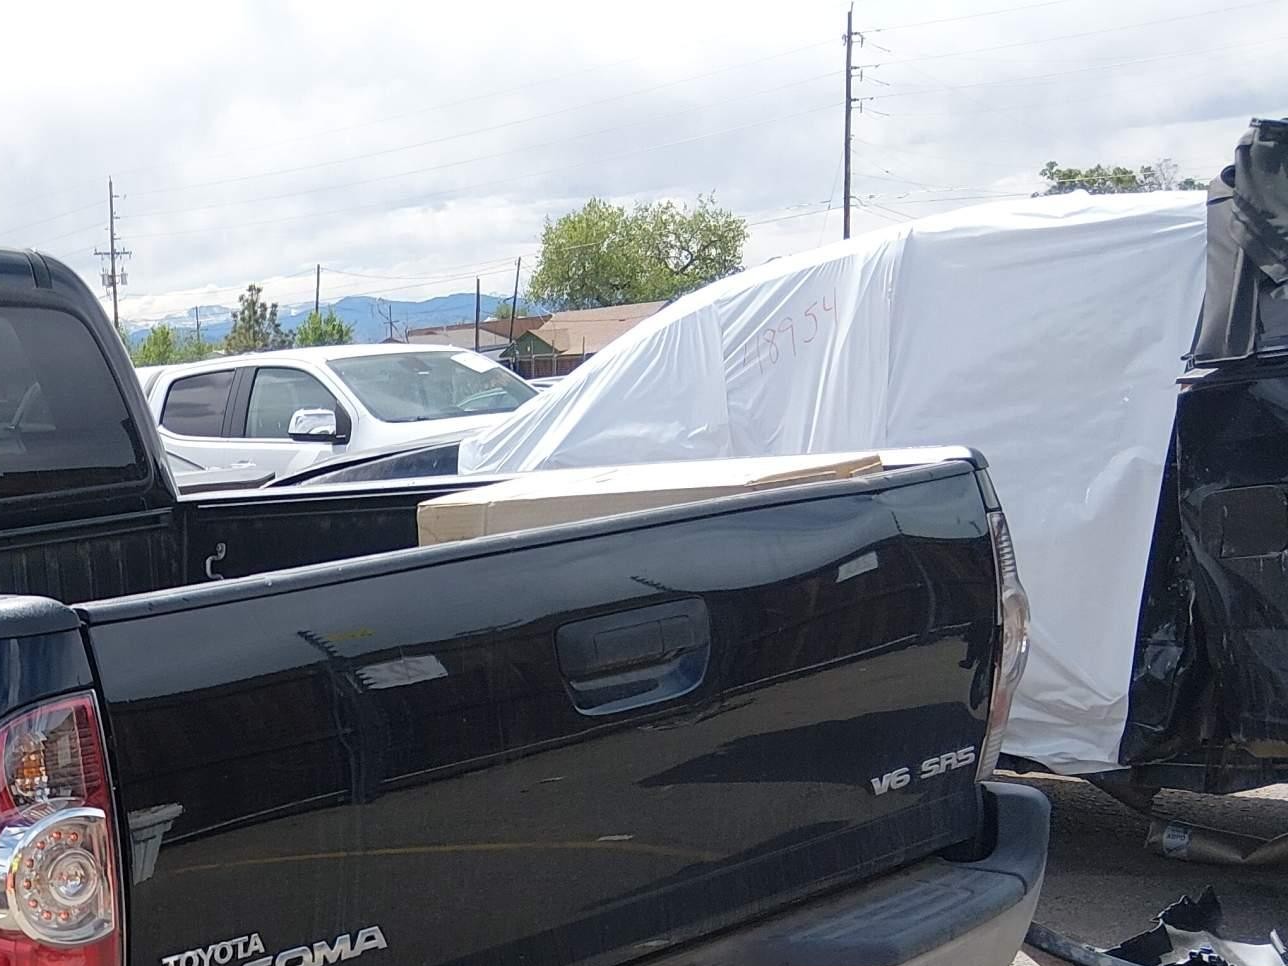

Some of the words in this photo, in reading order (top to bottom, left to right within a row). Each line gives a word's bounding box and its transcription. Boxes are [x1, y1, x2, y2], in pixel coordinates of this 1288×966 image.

[742, 287, 839, 376] 48954
[870, 767, 911, 796] V6
[920, 746, 976, 779] SR5
